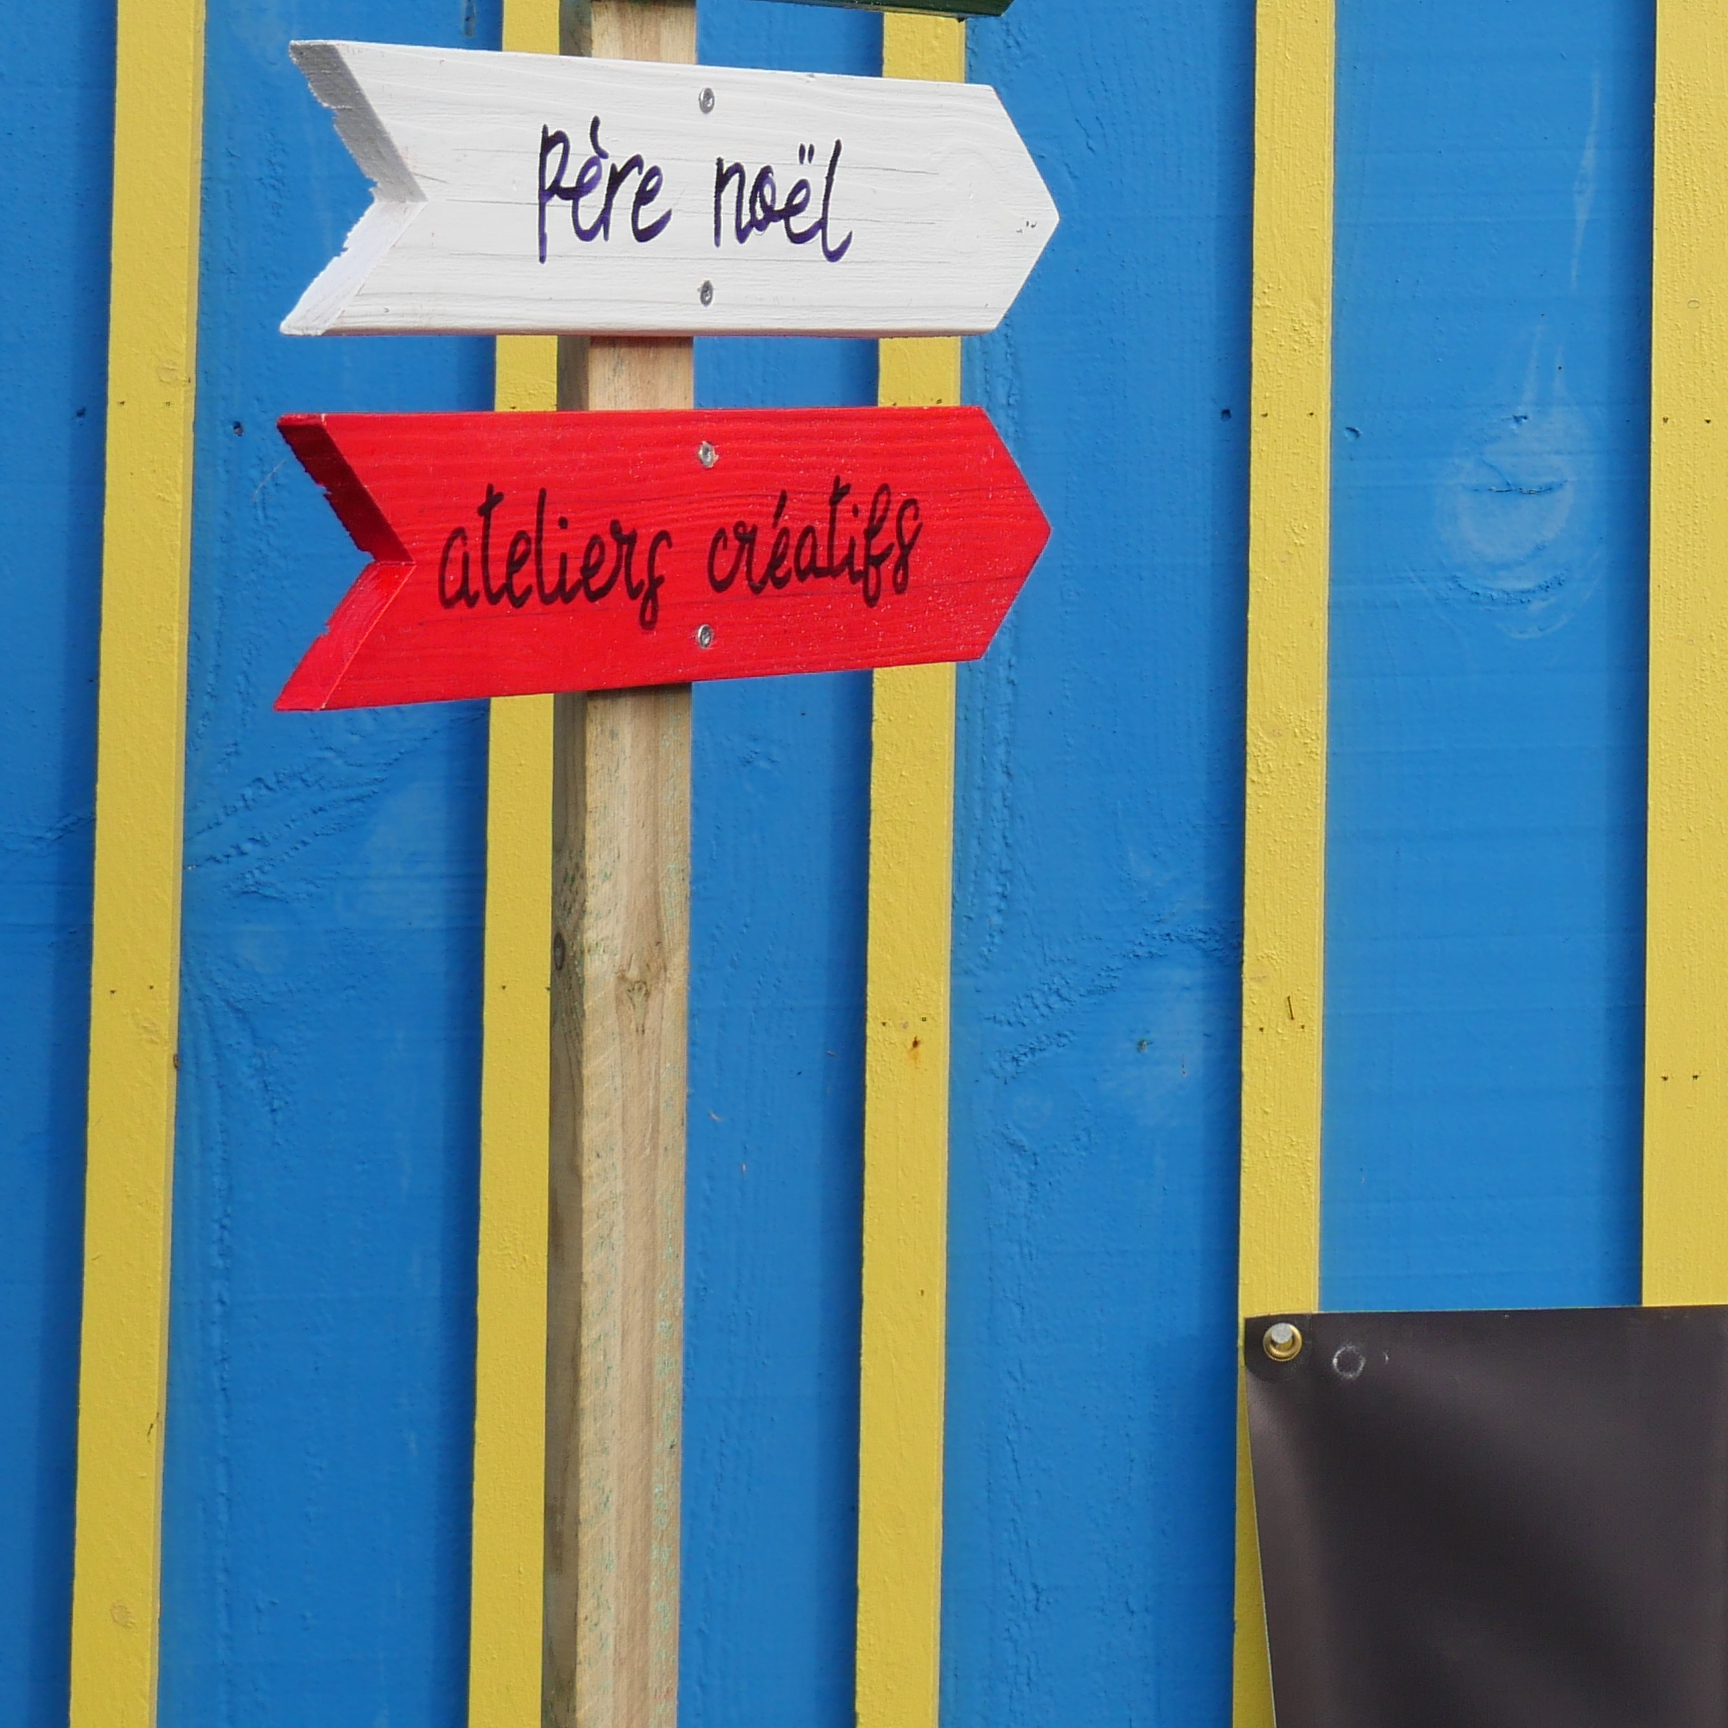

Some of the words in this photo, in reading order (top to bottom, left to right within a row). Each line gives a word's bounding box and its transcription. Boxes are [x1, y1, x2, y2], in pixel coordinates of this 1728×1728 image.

[713, 139, 853, 263] noël
[437, 483, 672, 631] ateliers
[707, 475, 924, 608] créatifs
